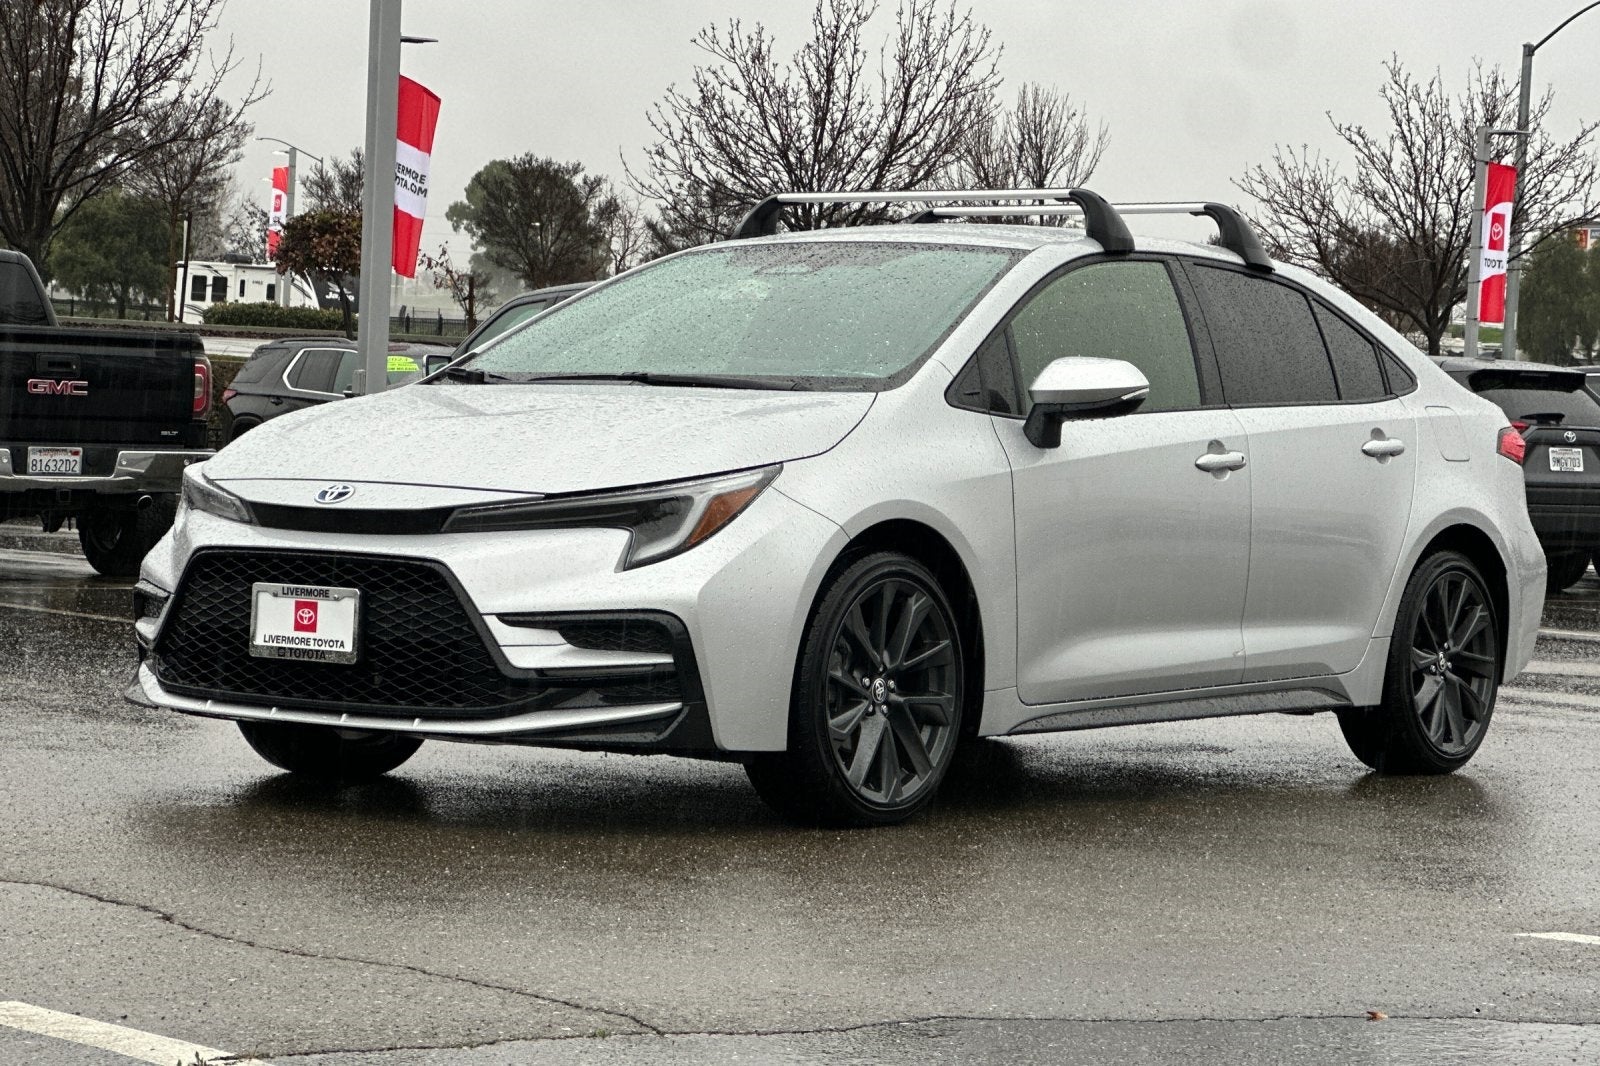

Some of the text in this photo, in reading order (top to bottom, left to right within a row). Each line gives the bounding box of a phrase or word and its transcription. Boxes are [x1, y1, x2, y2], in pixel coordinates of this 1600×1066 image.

[27, 379, 88, 395] GMC
[31, 458, 78, 473] 81632D2
[282, 586, 330, 598] LIVERMORE
[263, 634, 345, 649] LIVERMORE TOYOTA
[288, 648, 326, 660] TOYOTA
